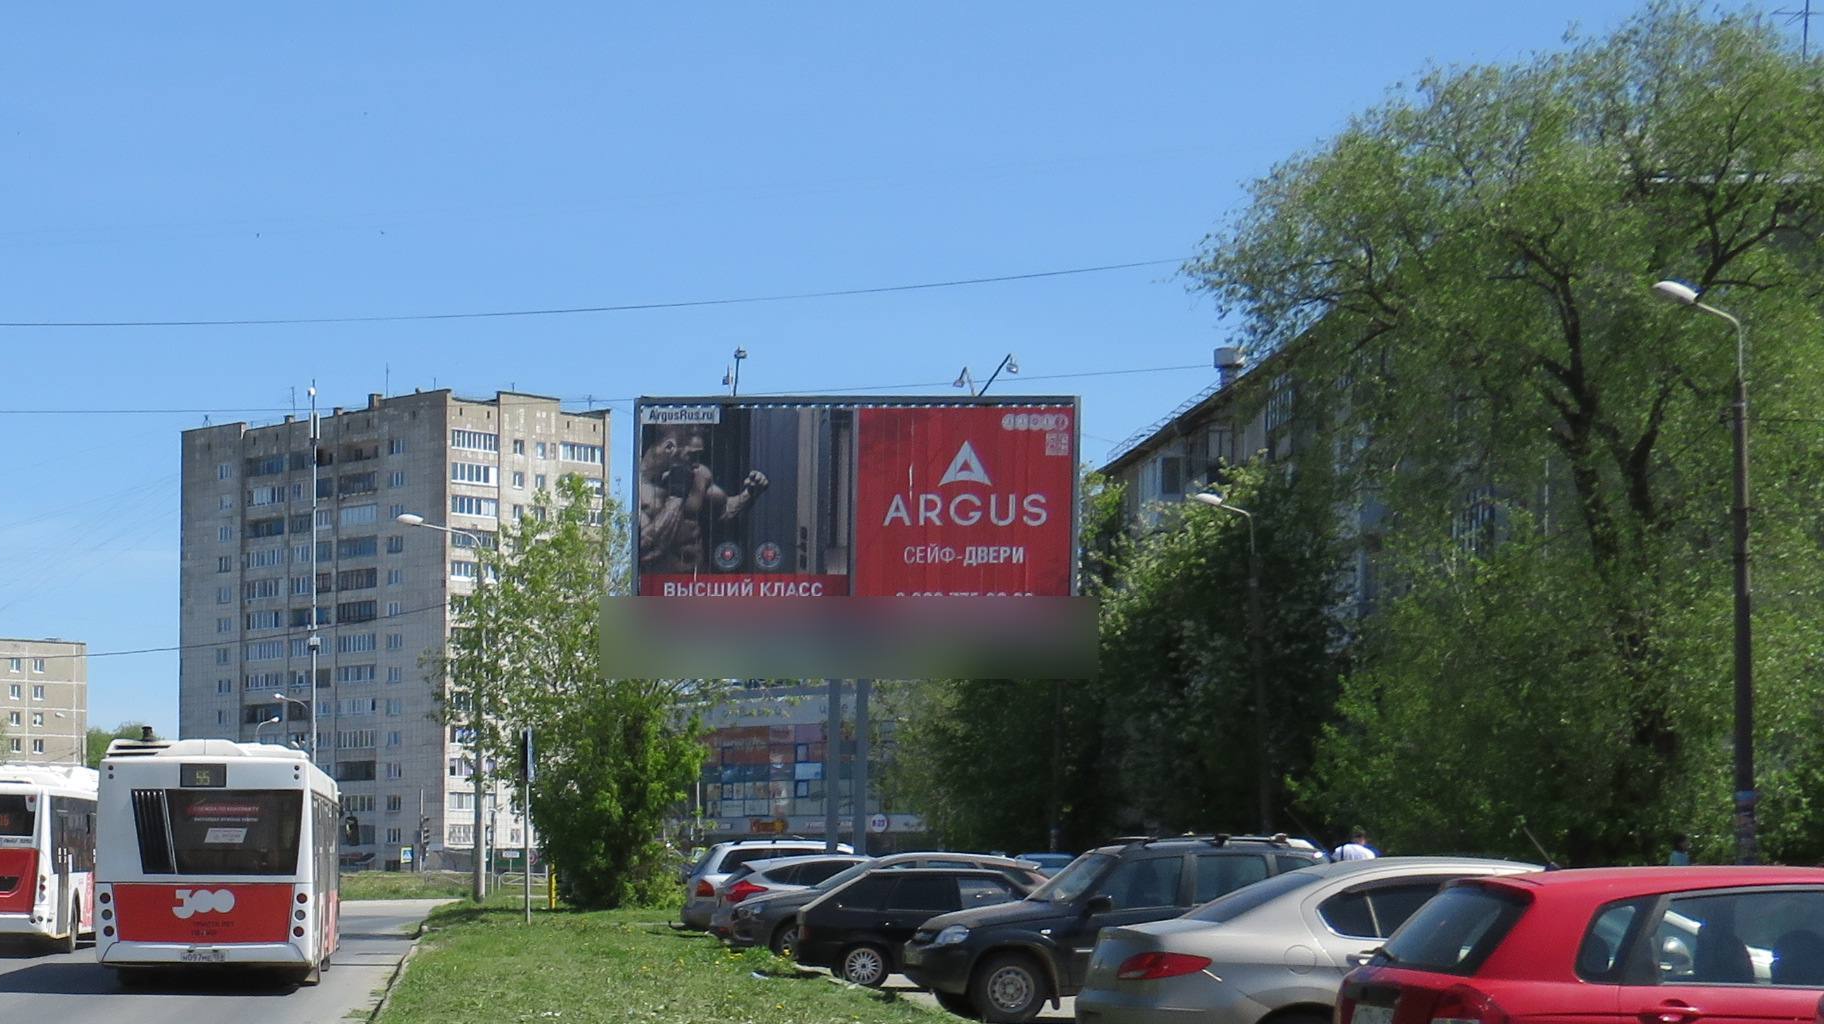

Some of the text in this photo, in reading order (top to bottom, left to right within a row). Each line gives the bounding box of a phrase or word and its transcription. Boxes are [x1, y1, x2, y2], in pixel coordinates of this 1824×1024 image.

[649, 409, 713, 422] ArgusRus.ru
[882, 493, 1048, 527] ARGUS
[904, 544, 1024, 566] СЕЙФ-ДВЕРИ
[663, 578, 823, 597] ВЫСШИЙ КЛАСС
[172, 889, 236, 919] 300
